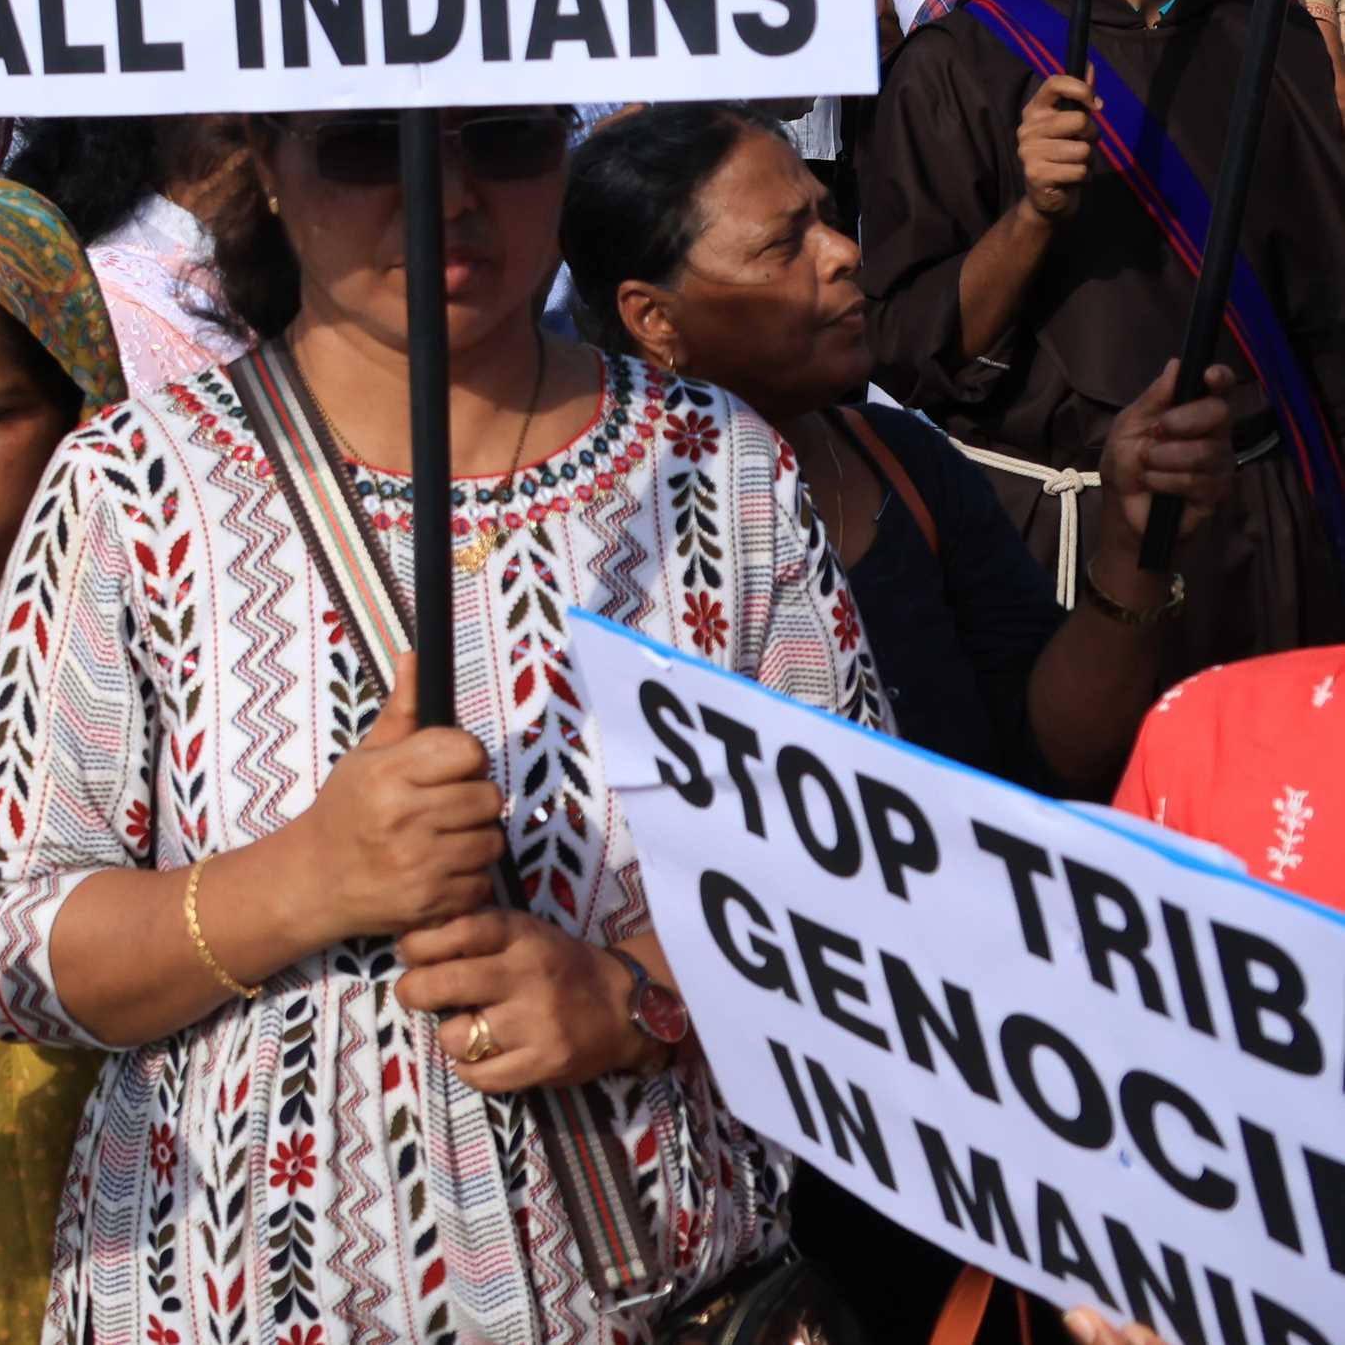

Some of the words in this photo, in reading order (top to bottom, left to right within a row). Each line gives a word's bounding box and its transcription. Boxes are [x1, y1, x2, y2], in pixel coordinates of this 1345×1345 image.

[639, 679, 941, 904] STOP
[971, 819, 1343, 1079] TRIB
[768, 1038, 899, 1194] IN
